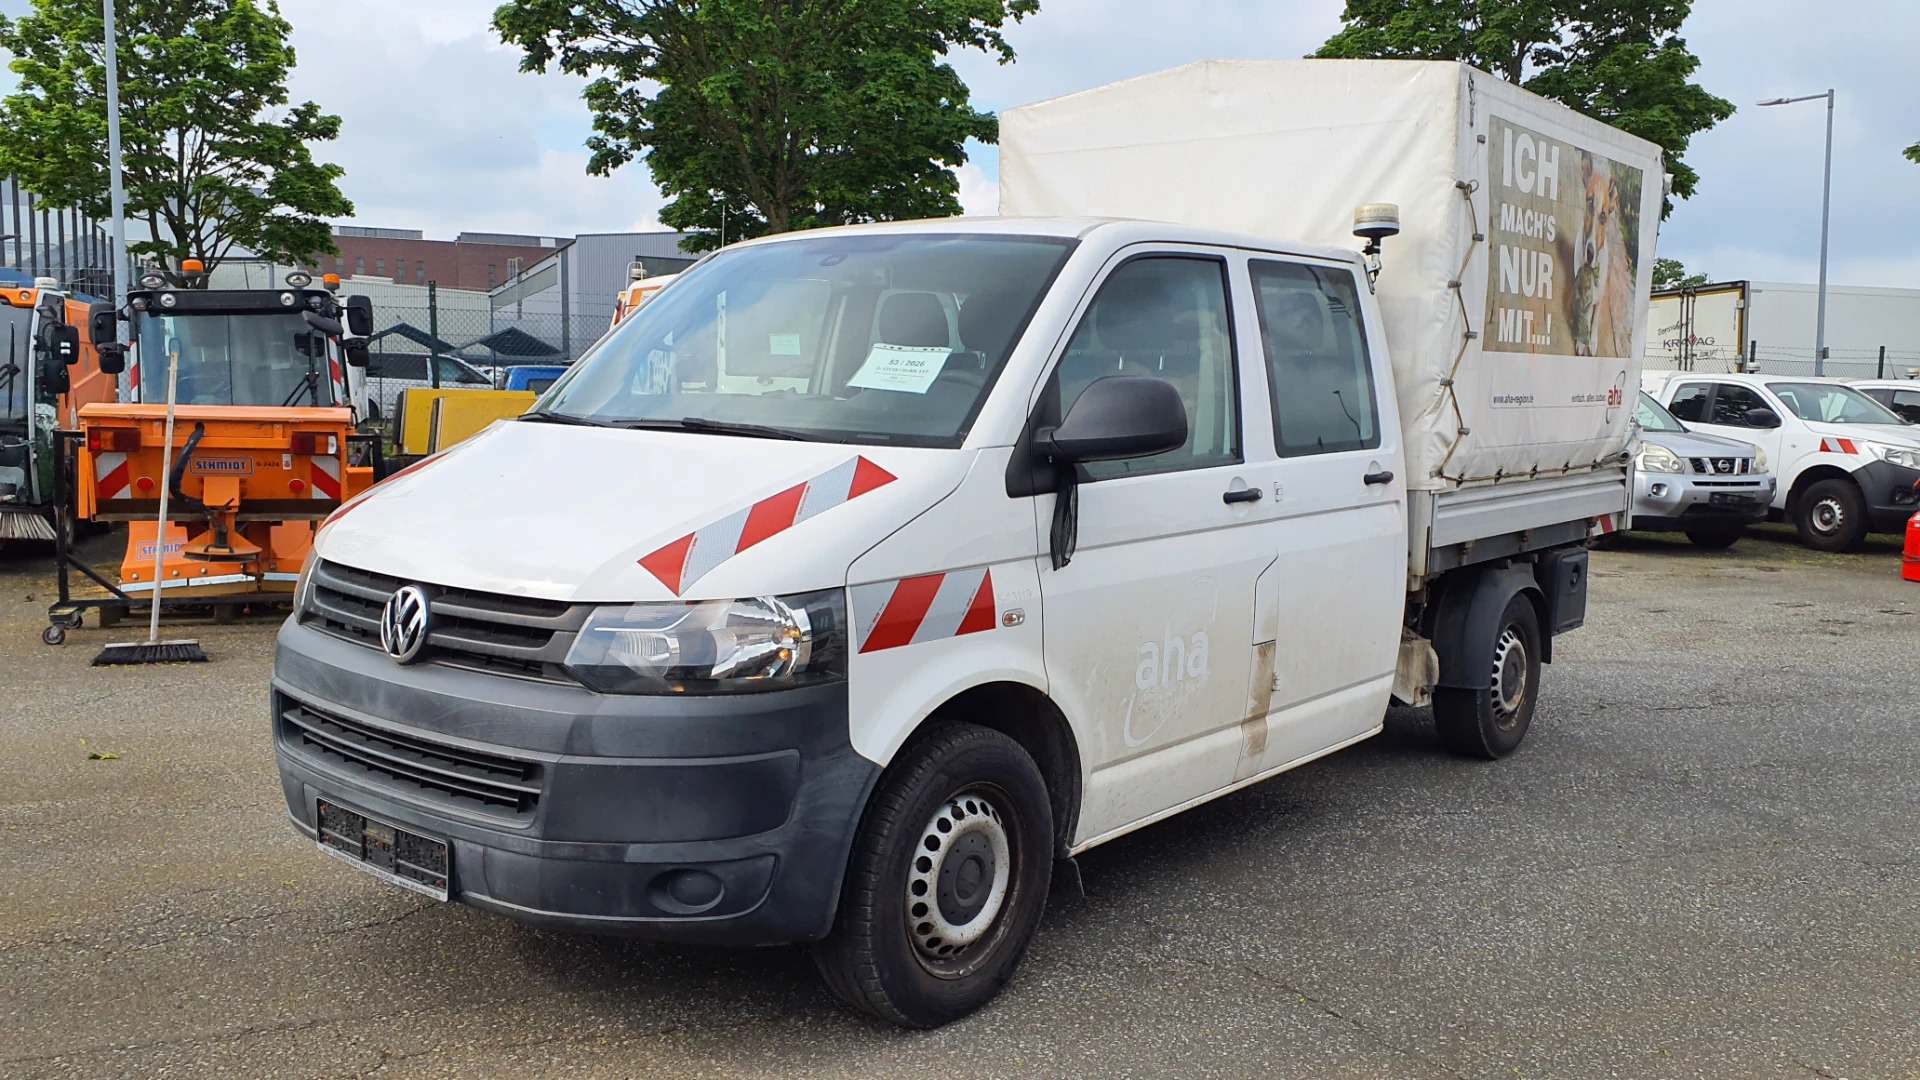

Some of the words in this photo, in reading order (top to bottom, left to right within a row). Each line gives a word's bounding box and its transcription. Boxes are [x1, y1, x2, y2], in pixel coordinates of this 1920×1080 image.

[1503, 127, 1559, 200] ICH
[1500, 203, 1556, 242] MACH'S
[1500, 245, 1553, 299] NUR
[1607, 385, 1622, 406] aha
[196, 461, 245, 470] SCHMIDT
[1135, 624, 1210, 690] aha
